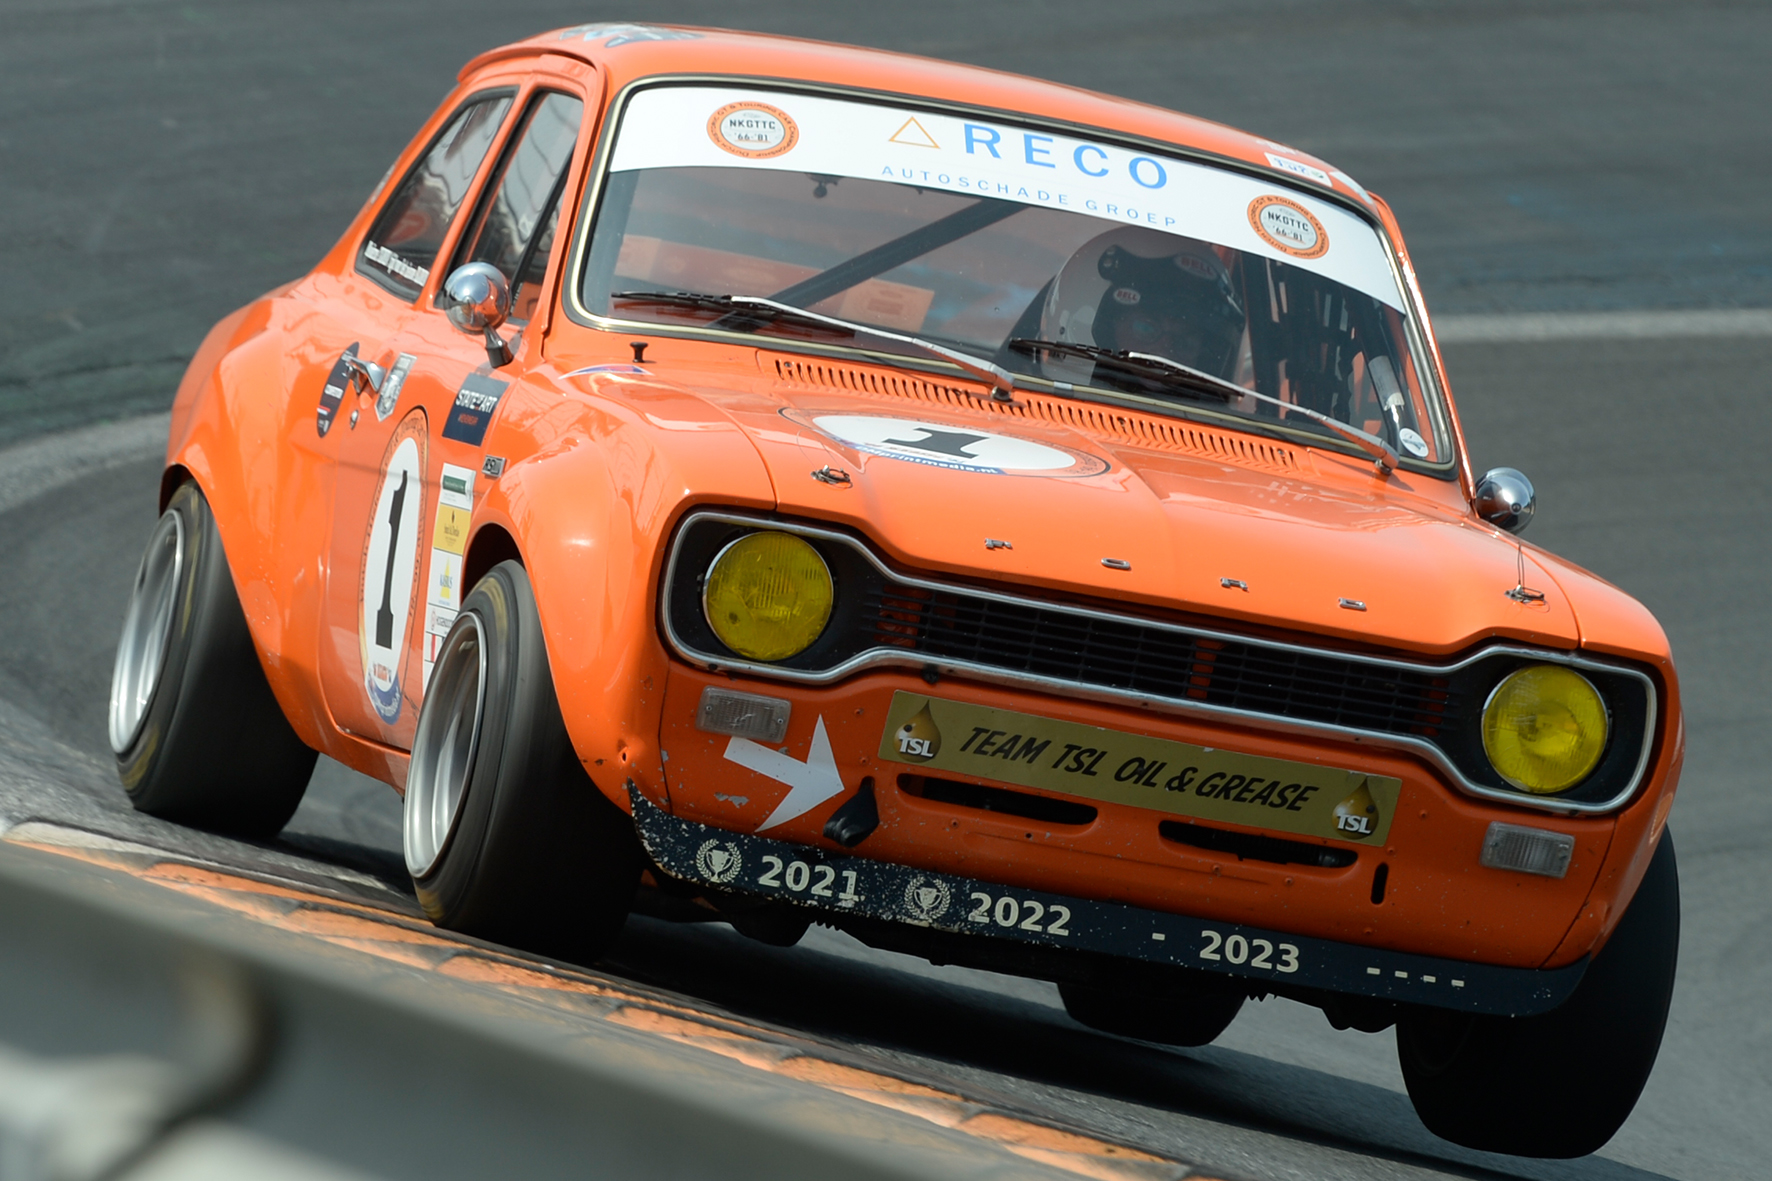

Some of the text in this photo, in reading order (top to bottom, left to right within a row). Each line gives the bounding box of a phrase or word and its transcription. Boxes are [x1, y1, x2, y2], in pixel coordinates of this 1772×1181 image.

[729, 119, 776, 130] NKGTTC
[964, 123, 1167, 189] RECO
[881, 165, 1175, 227] AUTOSCHADE GROEP
[1267, 211, 1309, 232] NKGTTC
[1181, 256, 1216, 278] BELL
[1116, 289, 1138, 301] BELL
[455, 389, 479, 409] STATE
[881, 427, 990, 459] 1
[375, 470, 407, 650] 1
[899, 736, 934, 758] TSL
[959, 726, 1320, 811] TEAM TSL OIL & GREASE
[1336, 814, 1372, 834] TSL
[758, 855, 1300, 973] 2021 2022 2023
